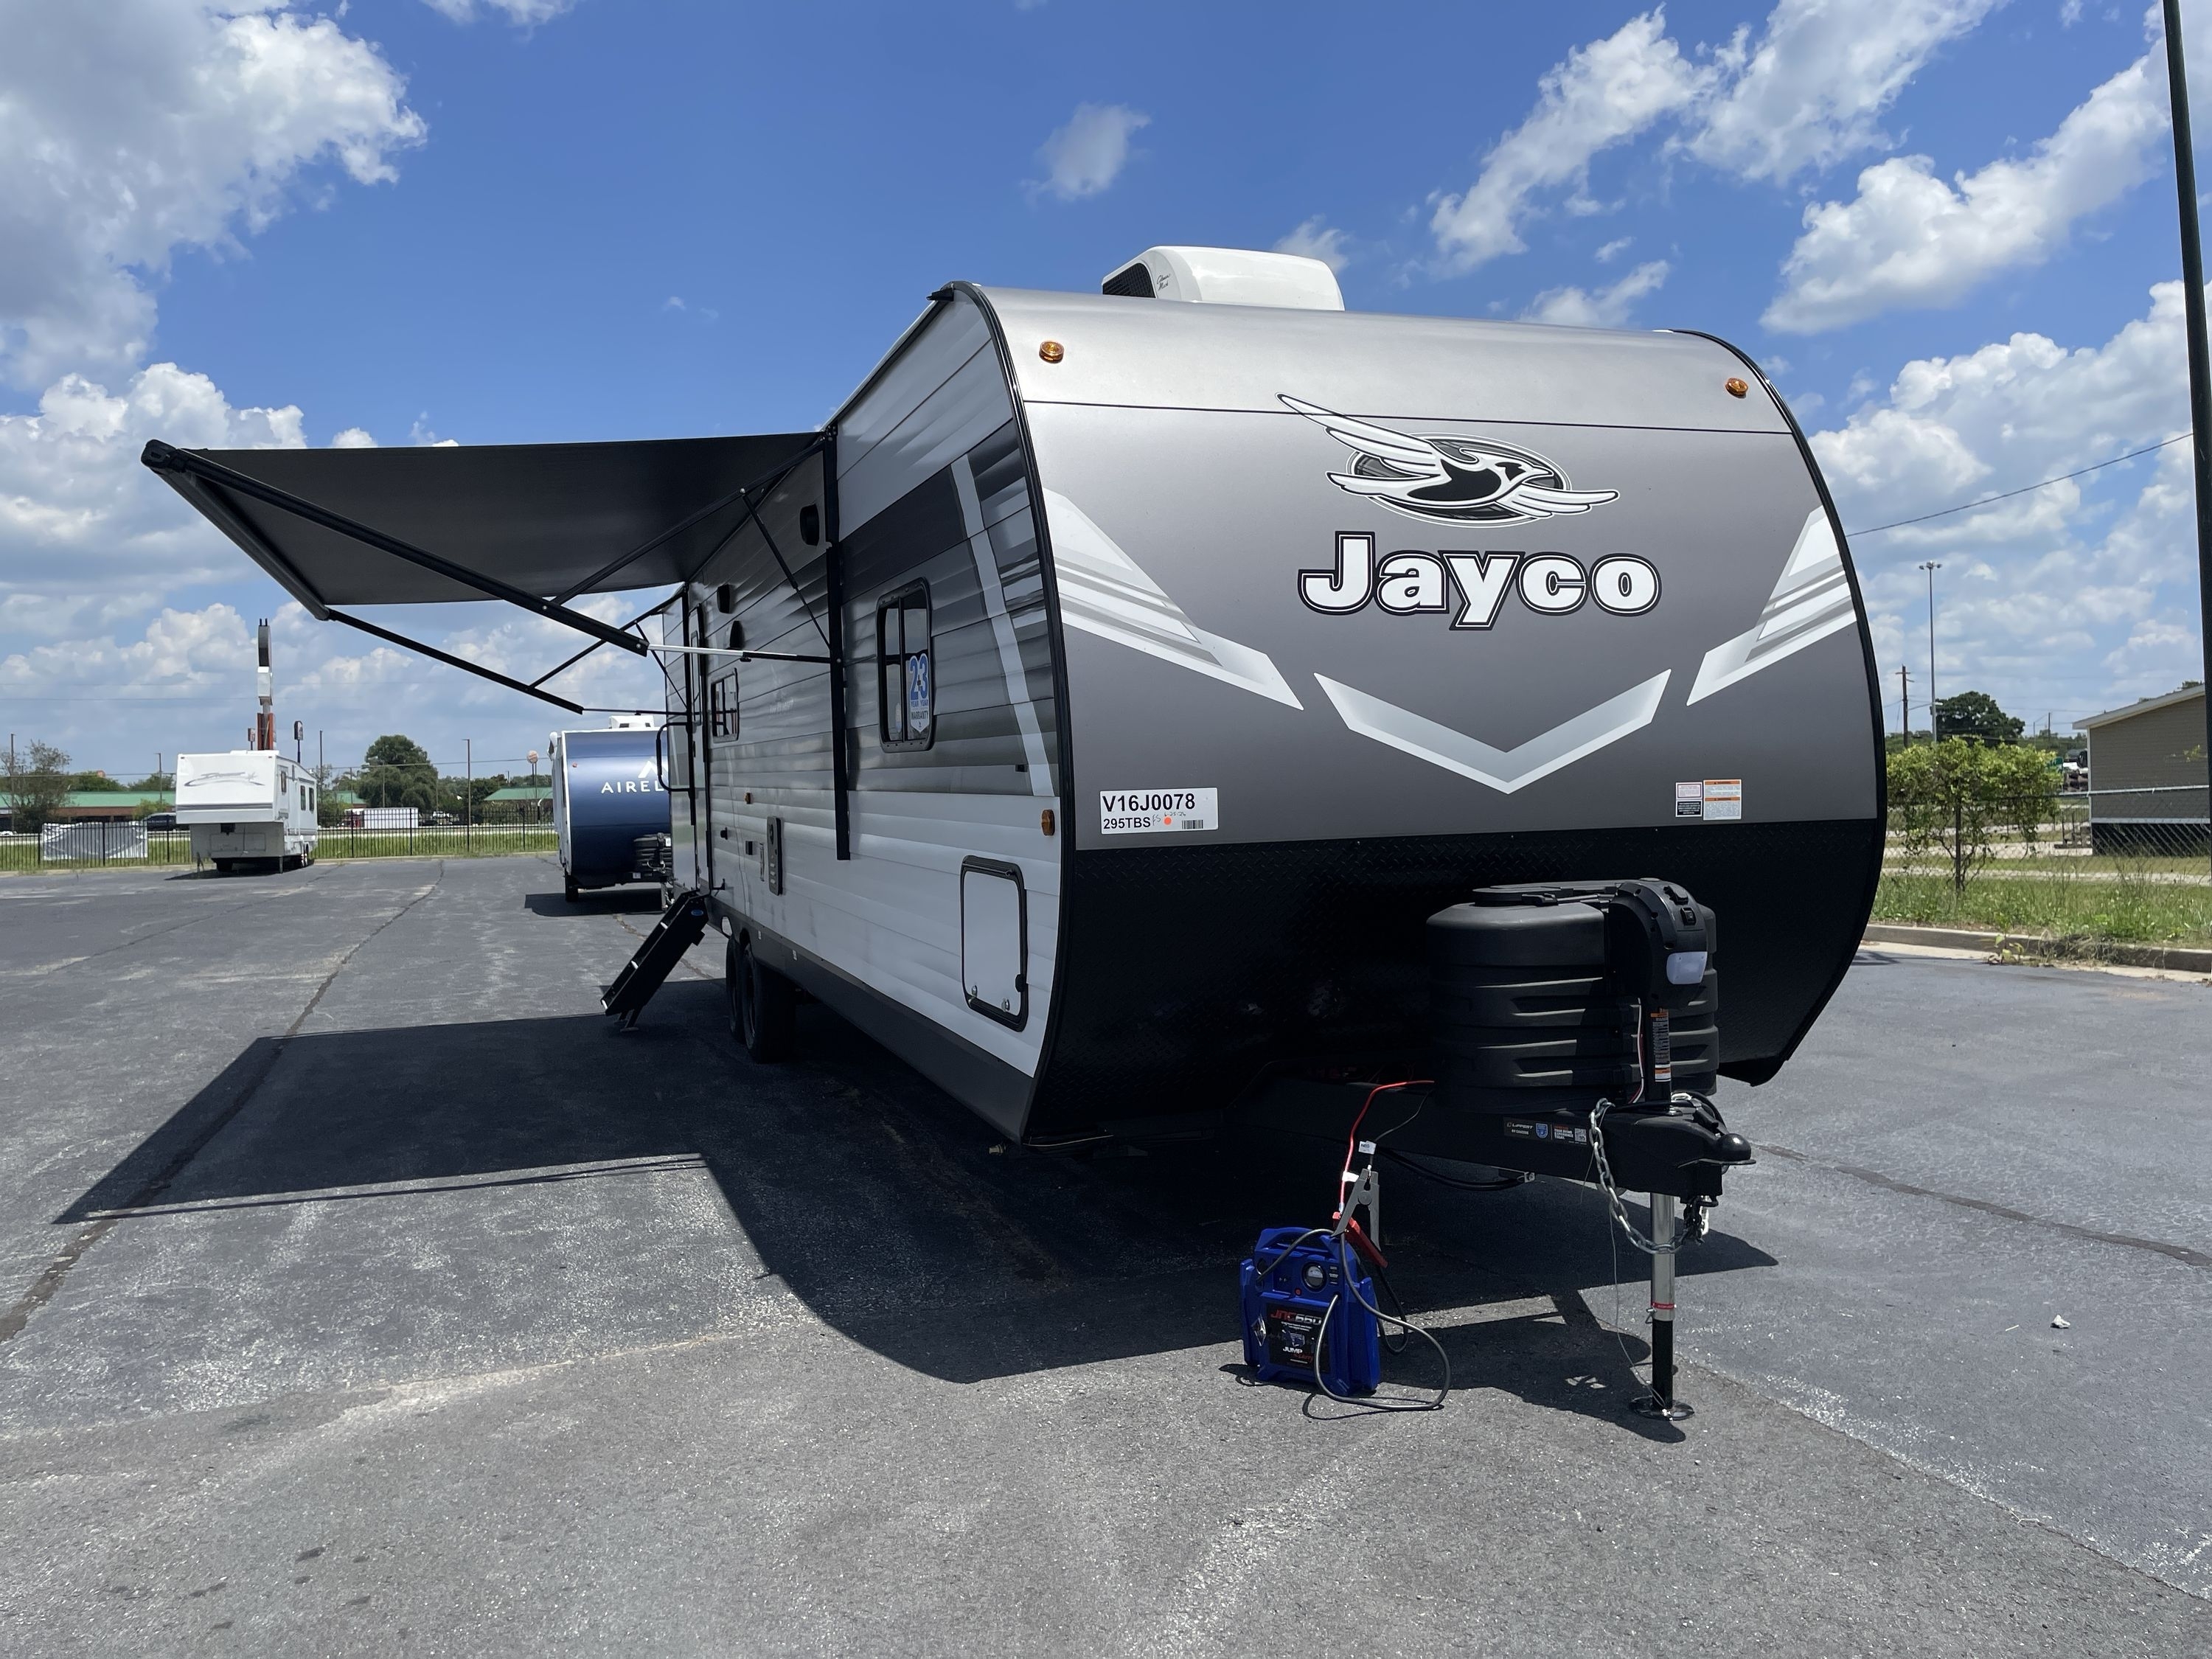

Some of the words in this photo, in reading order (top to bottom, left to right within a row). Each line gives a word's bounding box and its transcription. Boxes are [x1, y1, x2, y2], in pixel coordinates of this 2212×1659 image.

[1298, 531, 1662, 631] Jayco
[911, 710, 929, 720] WARRANTY
[1102, 793, 1195, 812] V16J0078
[1103, 817, 1151, 830] 295TBS
